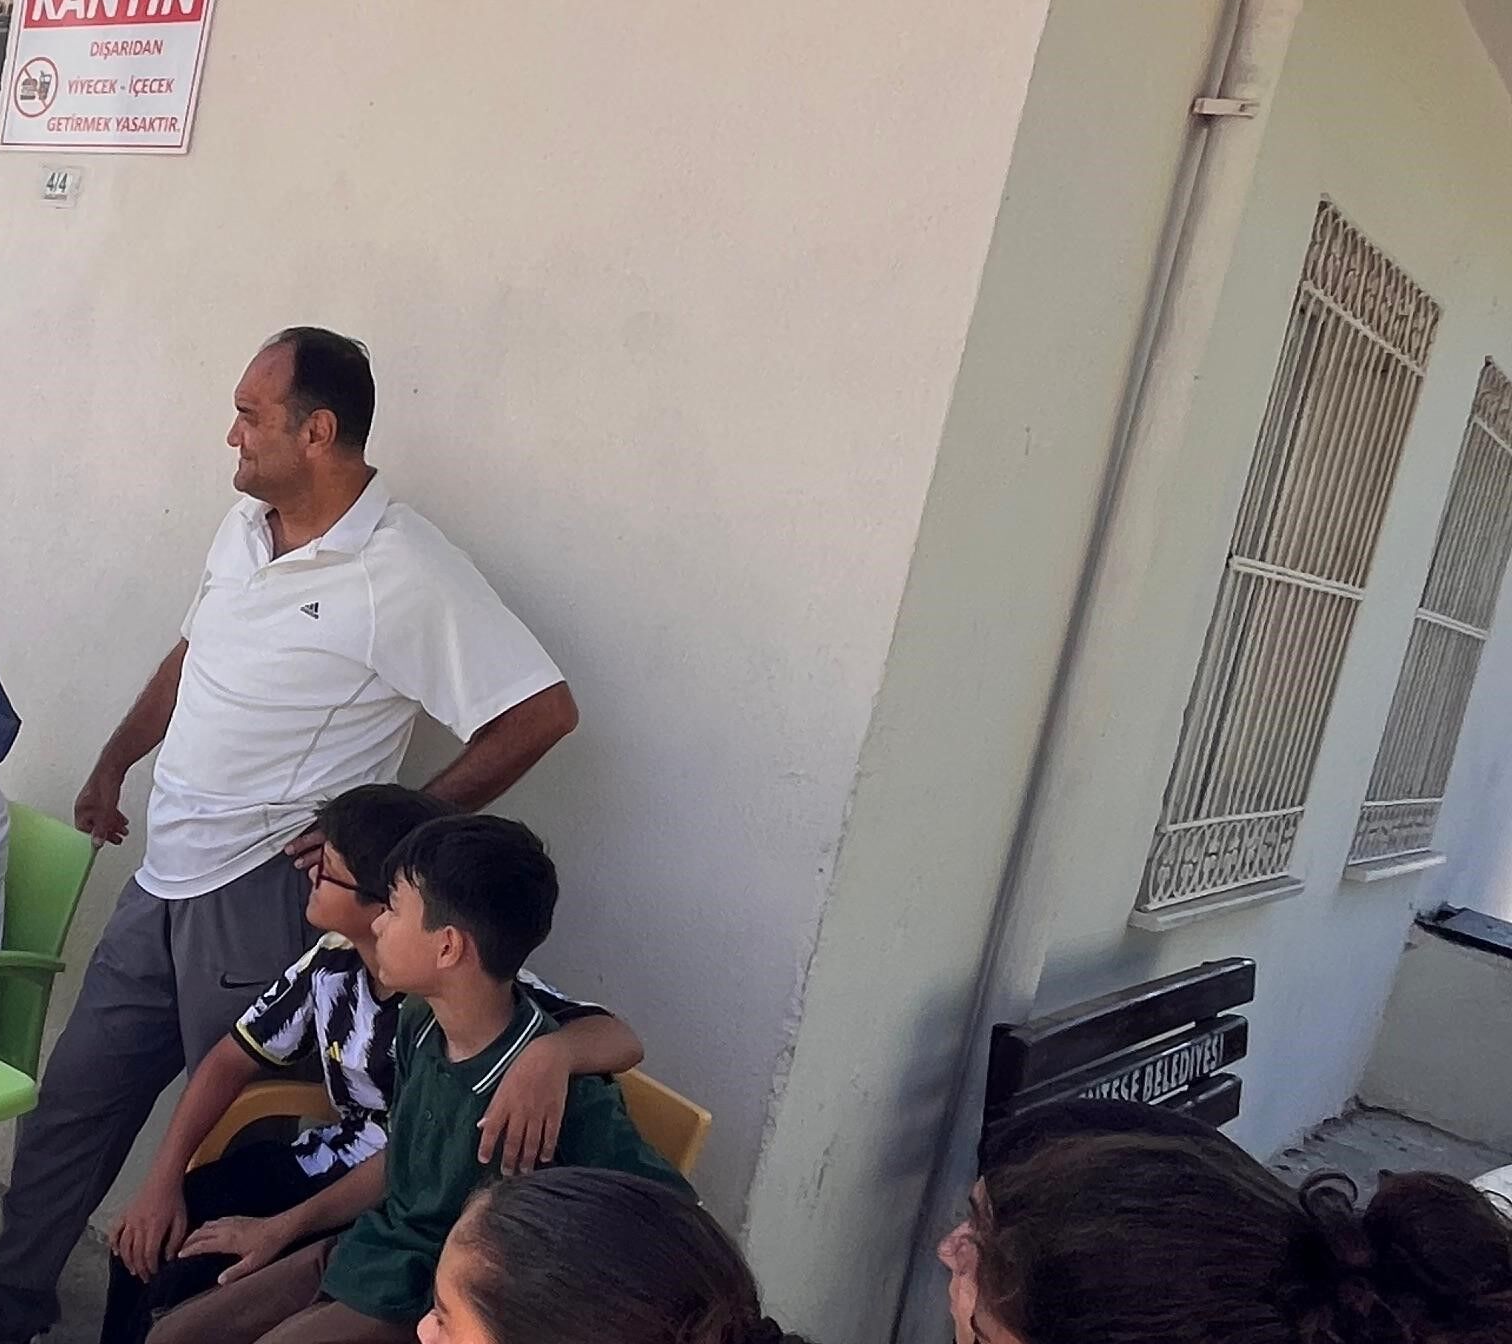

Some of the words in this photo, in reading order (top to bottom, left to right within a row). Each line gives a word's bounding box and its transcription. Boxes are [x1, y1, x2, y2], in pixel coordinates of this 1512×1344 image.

[89, 39, 163, 60] DIŞARIDAN
[67, 76, 117, 94] YİYECEK
[128, 74, 175, 97] İÇECEK
[47, 115, 111, 132] GETİRMEK
[46, 171, 68, 193] 4/4
